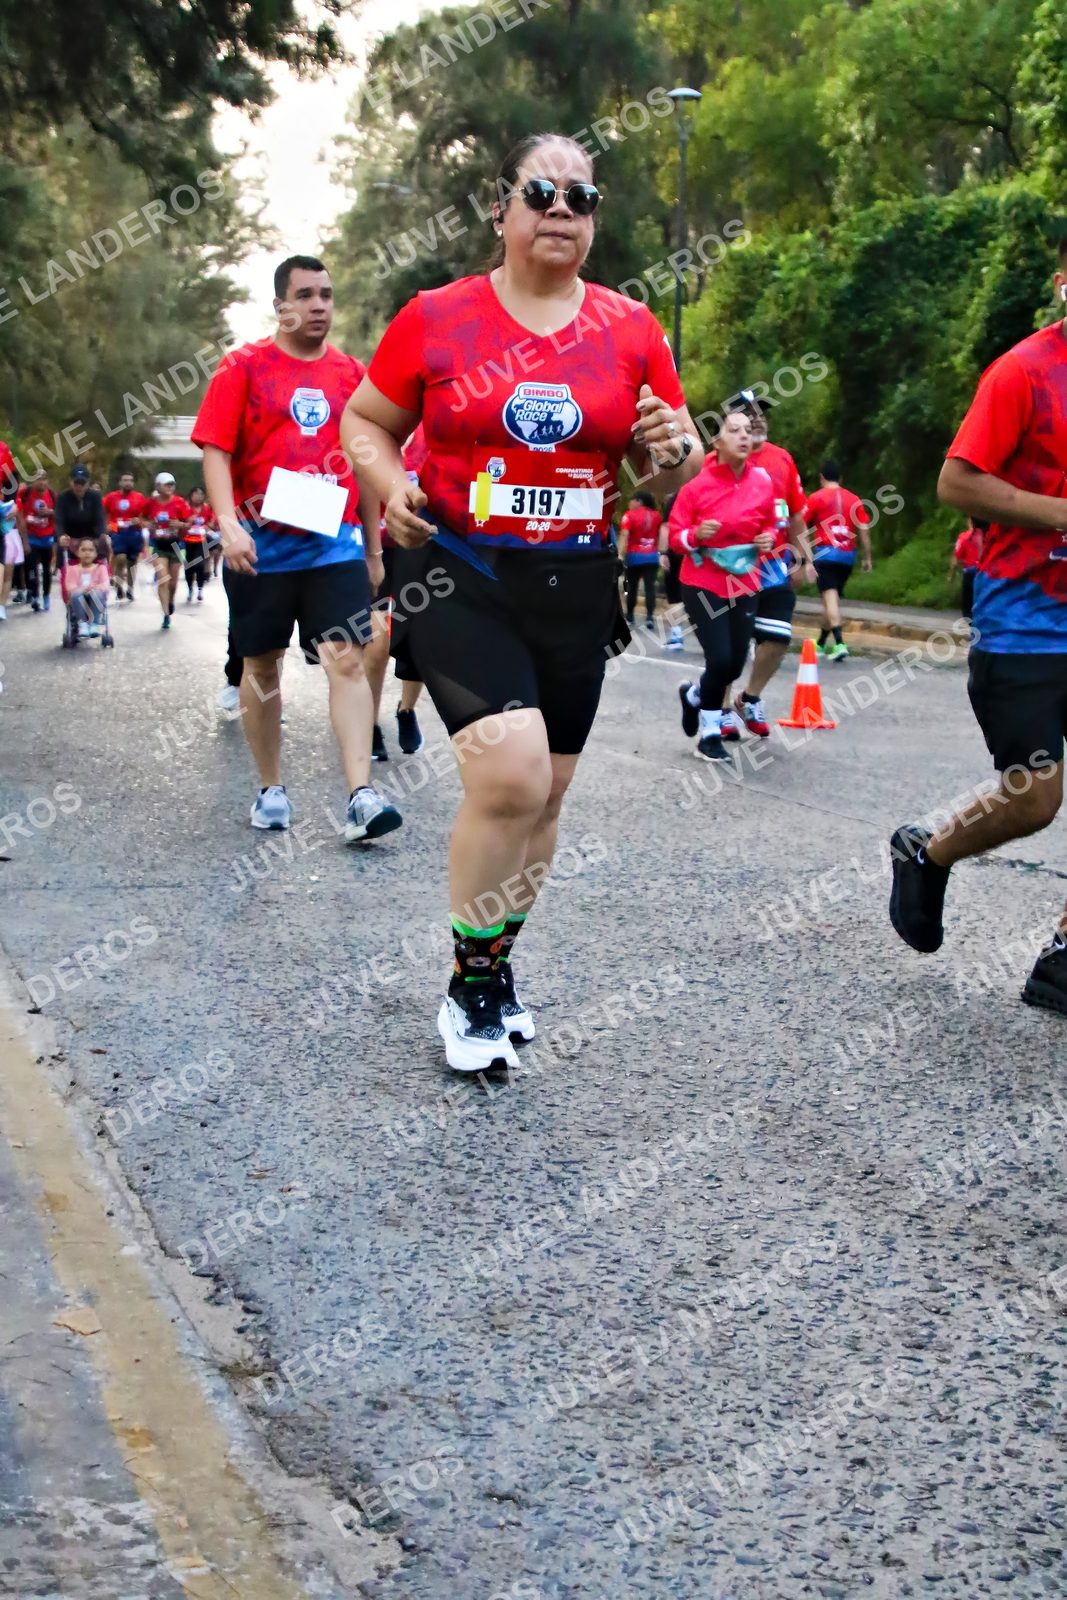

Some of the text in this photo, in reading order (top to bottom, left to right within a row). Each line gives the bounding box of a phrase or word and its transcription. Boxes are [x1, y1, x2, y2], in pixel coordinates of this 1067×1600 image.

[523, 388, 564, 398] BIMBO
[523, 399, 564, 413] Global
[515, 409, 548, 421] Race
[511, 487, 566, 517] 3197
[577, 535, 591, 544] 5K
